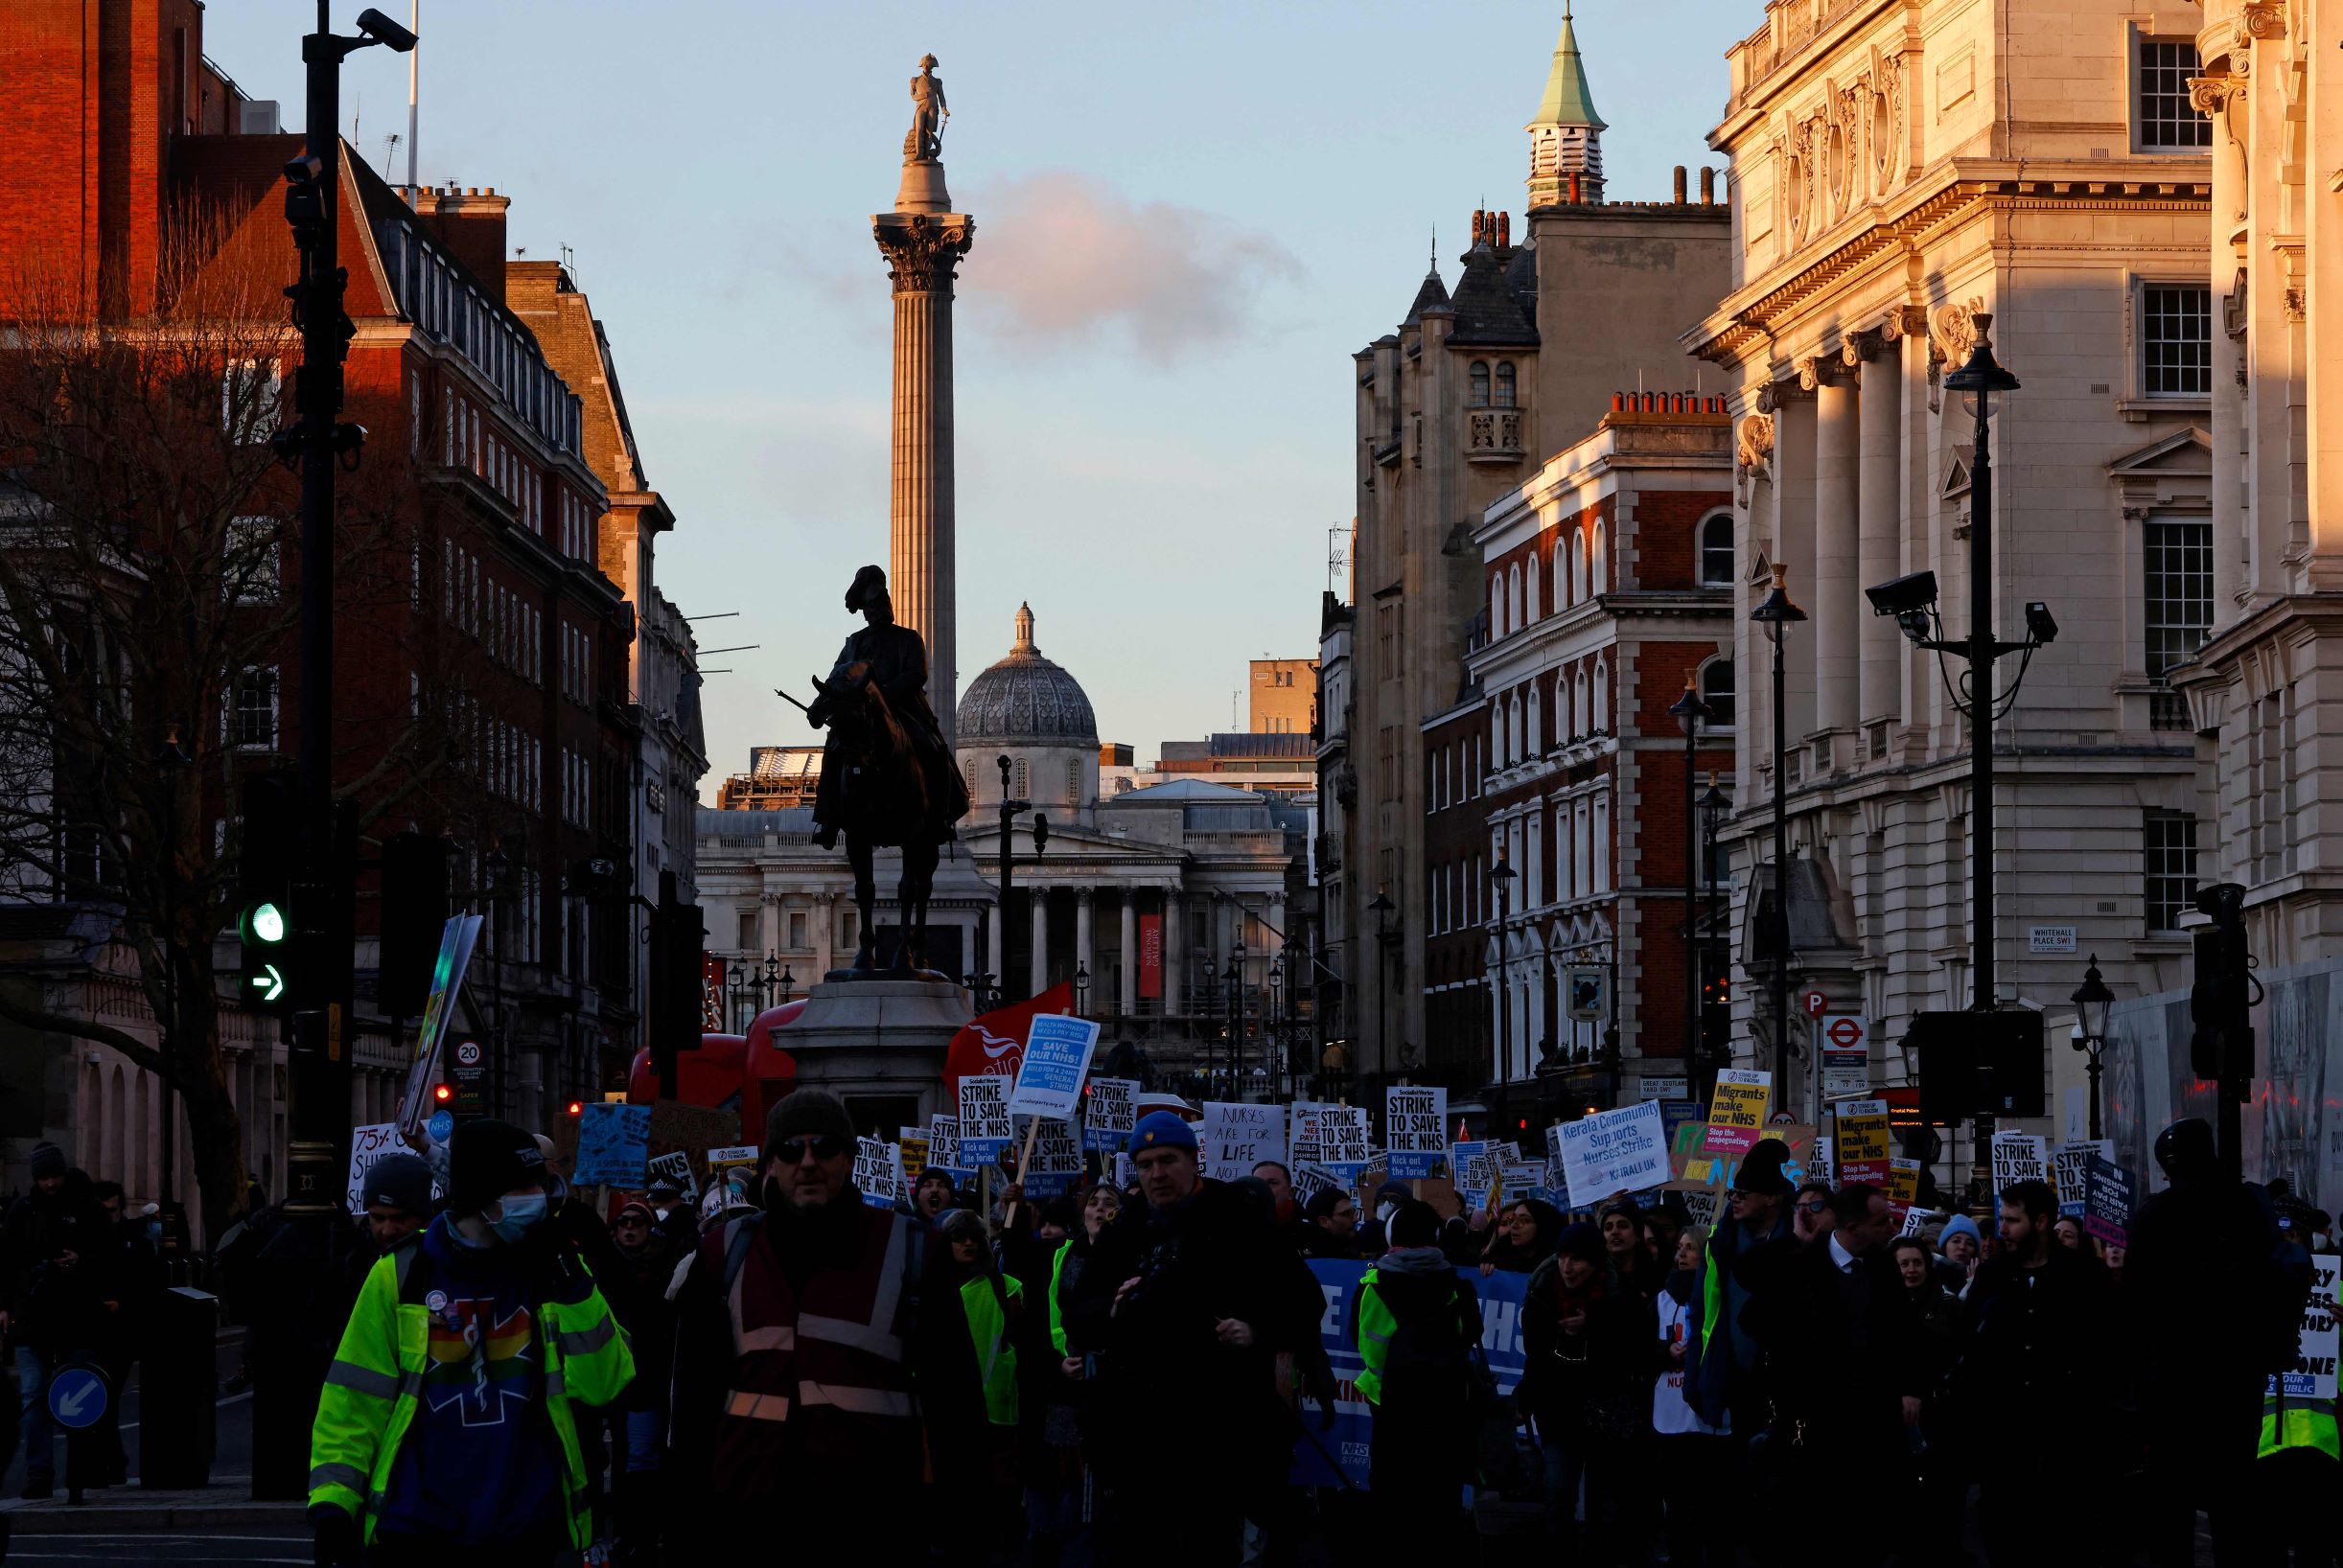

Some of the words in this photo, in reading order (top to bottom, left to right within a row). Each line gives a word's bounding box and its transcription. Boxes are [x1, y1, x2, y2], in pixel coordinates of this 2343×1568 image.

[1810, 995, 1821, 1012] P
[461, 1047, 477, 1058] 20
[1043, 1042, 1070, 1052] SAVE
[1030, 1050, 1051, 1060] OUR
[1055, 1052, 1079, 1064] NHS!
[1045, 1073, 1075, 1084] GENERAL
[962, 1085, 1001, 1102] STRIKE
[1049, 1082, 1074, 1091] STRIKE
[1092, 1085, 1129, 1102] STRIKE
[1717, 1085, 1765, 1099] Migrants
[962, 1104, 976, 1120] TO
[980, 1102, 1007, 1119] SAVE
[1090, 1100, 1102, 1114] TO
[1107, 1101, 1133, 1116] SAVE
[1390, 1096, 1434, 1114] STRIKE
[1714, 1100, 1743, 1111] make
[1089, 1114, 1108, 1129] THE
[1112, 1116, 1133, 1130] NHS
[1223, 1107, 1265, 1123] NURSES
[1321, 1111, 1357, 1127] STRIKE
[1564, 1119, 1597, 1140] Kerala
[1599, 1102, 1659, 1128] Community
[1712, 1114, 1728, 1123] our
[1731, 1115, 1755, 1125] NHS
[431, 1122, 451, 1133] NHS
[963, 1120, 983, 1137] THE
[987, 1119, 1009, 1137] NHS
[1390, 1115, 1405, 1132] TO
[1411, 1115, 1441, 1132] SAVE
[1841, 1119, 1886, 1135] Migrants
[1215, 1127, 1238, 1141] ARE
[1248, 1129, 1270, 1141] FOR
[1321, 1128, 1334, 1143] TO
[1338, 1127, 1363, 1143] SAVE
[1589, 1124, 1637, 1148] Supports
[1709, 1127, 1724, 1137] Stop
[357, 1129, 389, 1151] 75%
[932, 1137, 945, 1150] TO
[964, 1142, 977, 1151] Kick
[1043, 1139, 1076, 1155] SAVE
[1099, 1141, 1116, 1150] Tories
[1390, 1133, 1414, 1150] THE
[1419, 1133, 1444, 1150] NHS
[1707, 1135, 1750, 1146] scapegoating
[1842, 1136, 1870, 1145] make
[858, 1141, 891, 1162] STRIKE
[930, 1151, 951, 1166] THE
[964, 1153, 975, 1163] the
[976, 1153, 995, 1163] Tories
[1222, 1143, 1255, 1161] LIFE
[1322, 1145, 1342, 1161] THE
[1345, 1144, 1365, 1161] NHS
[1583, 1146, 1620, 1165] Nurses
[1622, 1137, 1653, 1155] Strike
[1843, 1150, 1860, 1160] our
[1864, 1145, 1883, 1158] NHS
[1995, 1144, 2035, 1160] STRIKE
[650, 1155, 688, 1175] NHS
[1021, 1156, 1047, 1171] HE
[1052, 1156, 1079, 1171] NHS
[1392, 1155, 1407, 1165] Kick
[1409, 1156, 1421, 1165] out
[1643, 1158, 1657, 1169] UK
[856, 1157, 868, 1174] TO
[870, 1161, 893, 1179] SAVE
[1216, 1166, 1241, 1179] NOT
[1392, 1166, 1403, 1176] the
[1405, 1166, 1427, 1176] Tories
[1470, 1170, 1478, 1179] TO
[1995, 1161, 2010, 1176] TO
[2014, 1162, 2042, 1176] SAVE
[1042, 1177, 1055, 1186] out
[1469, 1180, 1481, 1188] THE
[1843, 1171, 1883, 1182] scapegoating
[2058, 1170, 2076, 1186] TO
[2092, 1171, 2128, 1195] NURSING
[855, 1174, 871, 1192] THE
[874, 1178, 893, 1197] NHS
[1024, 1187, 1035, 1196] the
[1038, 1187, 1061, 1196] Tories
[2102, 1185, 2119, 1198] FOR
[1892, 1189, 1910, 1198] NHS
[2060, 1186, 2085, 1202] THE
[2093, 1189, 2108, 1202] PAY
[1686, 1195, 1716, 1212] PUBLI
[2092, 1197, 2128, 1219] SUPPORT
[2109, 1197, 2128, 1211] FAIR
[2098, 1210, 2113, 1222] YOU
[2284, 1385, 2313, 1394] UBLIC
[1342, 1443, 1369, 1456] NHS
